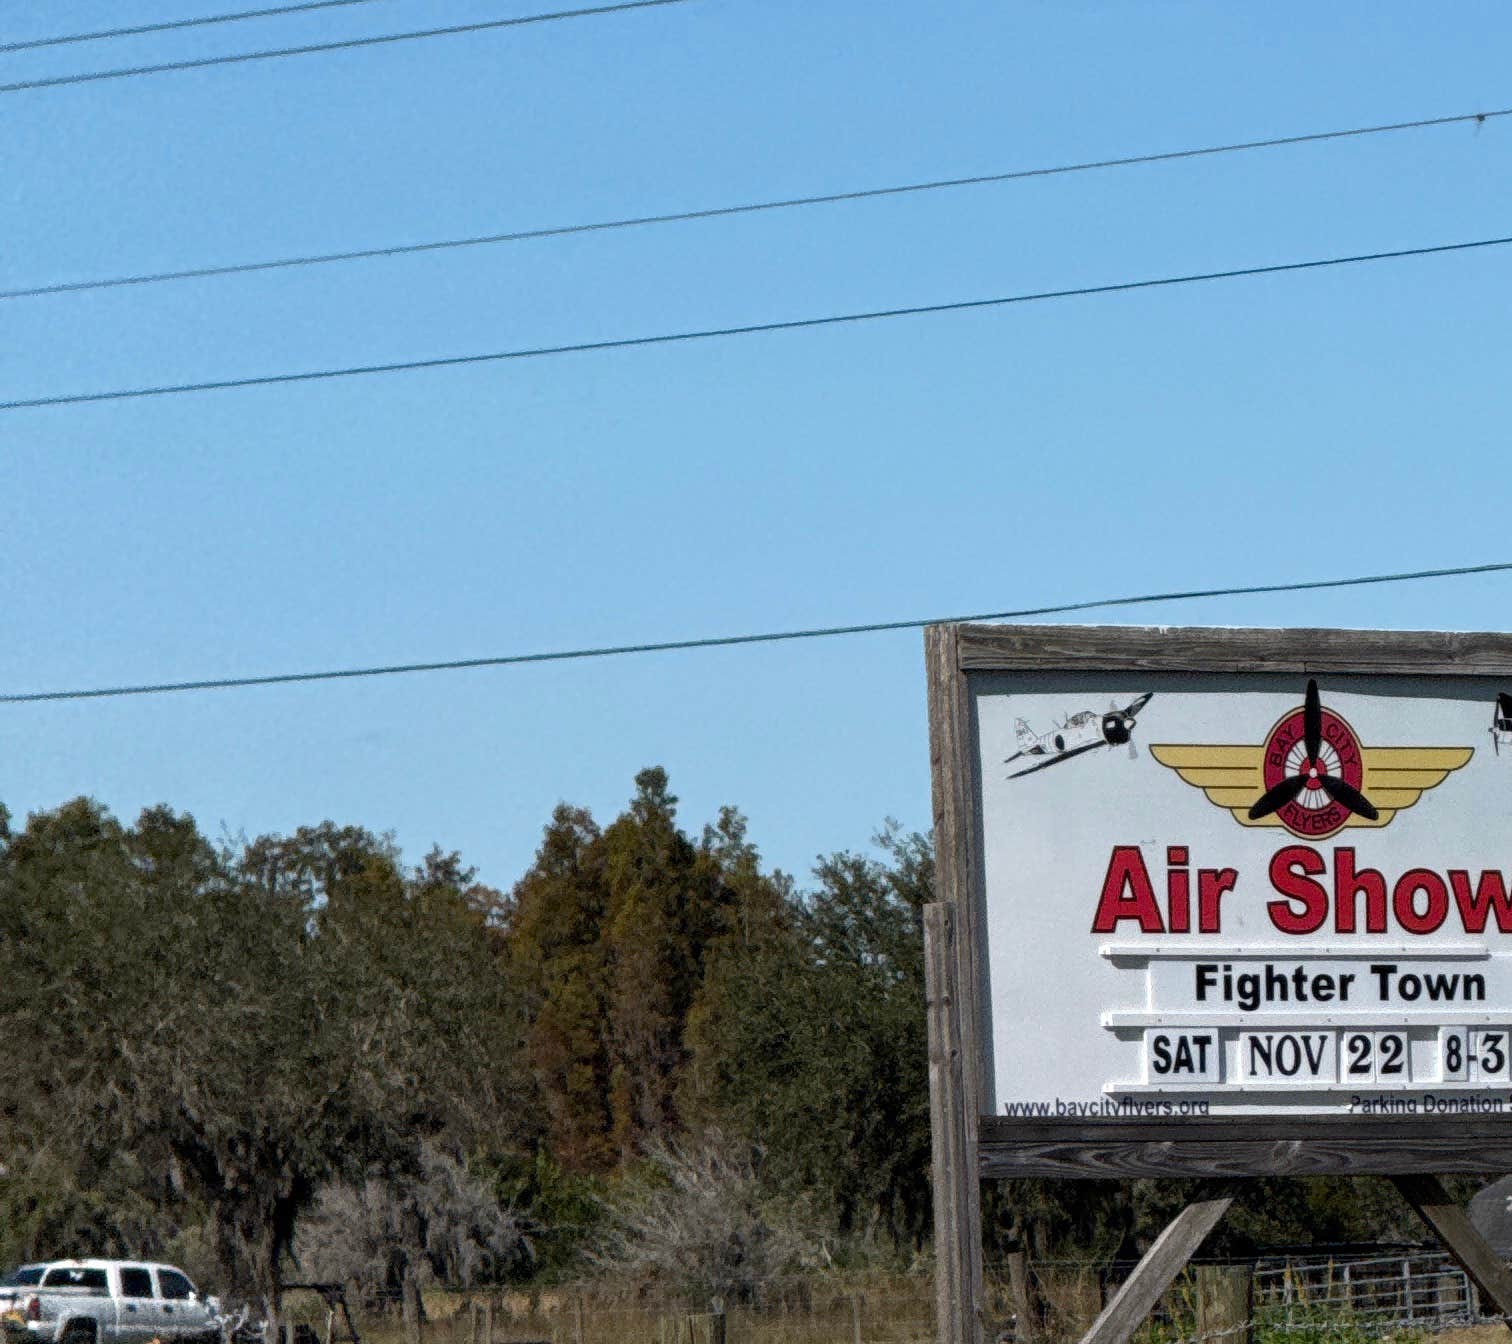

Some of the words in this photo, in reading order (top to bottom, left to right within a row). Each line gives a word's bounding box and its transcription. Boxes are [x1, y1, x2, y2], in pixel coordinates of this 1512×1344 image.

[1270, 725, 1296, 768] BAY
[1326, 723, 1358, 766] CITY
[1283, 803, 1342, 831] FLYERS
[1090, 845, 1239, 934] Air
[1195, 964, 1356, 1012] Fighter
[1370, 964, 1486, 1001] Town
[1152, 1034, 1213, 1074] SAT
[1248, 1035, 1329, 1076] NOV
[1347, 1034, 1405, 1074] 22
[1445, 1034, 1506, 1073] 8-3
[1004, 1096, 1209, 1116] www.baycityflyers.org
[1350, 1095, 1417, 1114] Parking
[1423, 1094, 1504, 1113] Donation
